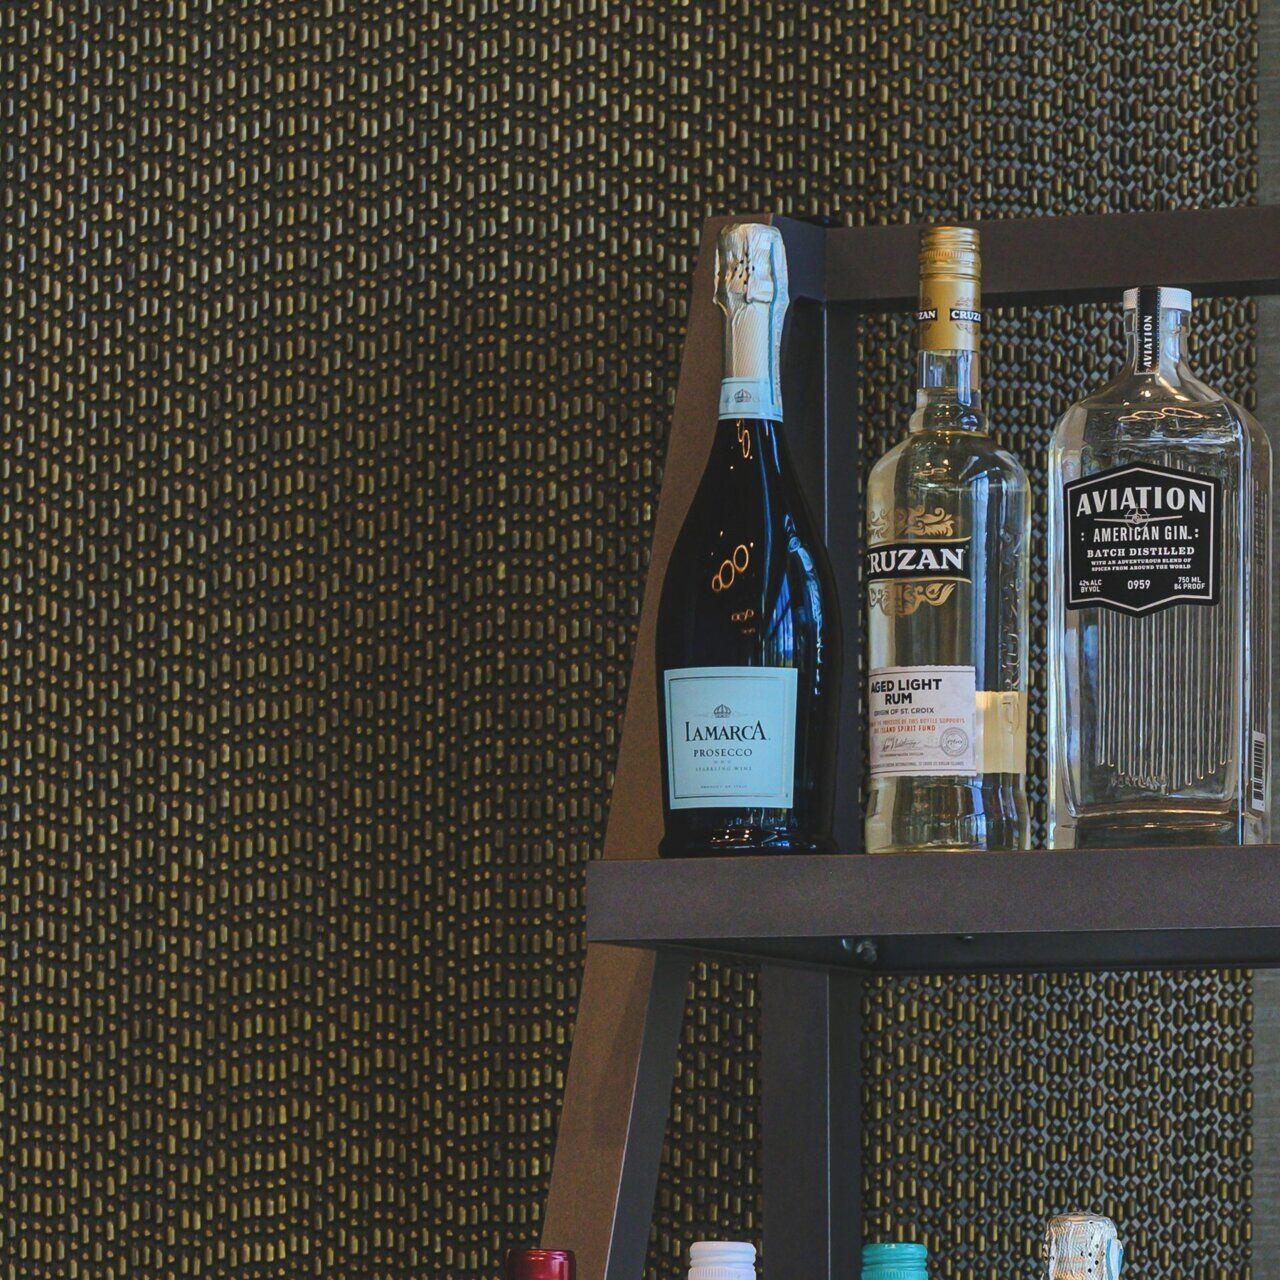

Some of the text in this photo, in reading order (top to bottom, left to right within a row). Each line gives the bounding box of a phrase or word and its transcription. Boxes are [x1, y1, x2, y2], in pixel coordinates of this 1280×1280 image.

[1143, 316, 1152, 368] AVIATION
[1076, 487, 1206, 517] AVIATION
[1093, 526, 1159, 542] AMERICAN
[1087, 547, 1194, 558] BATCH DISTILLED
[1127, 580, 1150, 589] 0959
[871, 679, 942, 693] AGED LIGHT
[885, 693, 912, 705] RUM
[694, 749, 752, 757] PROSECCO
